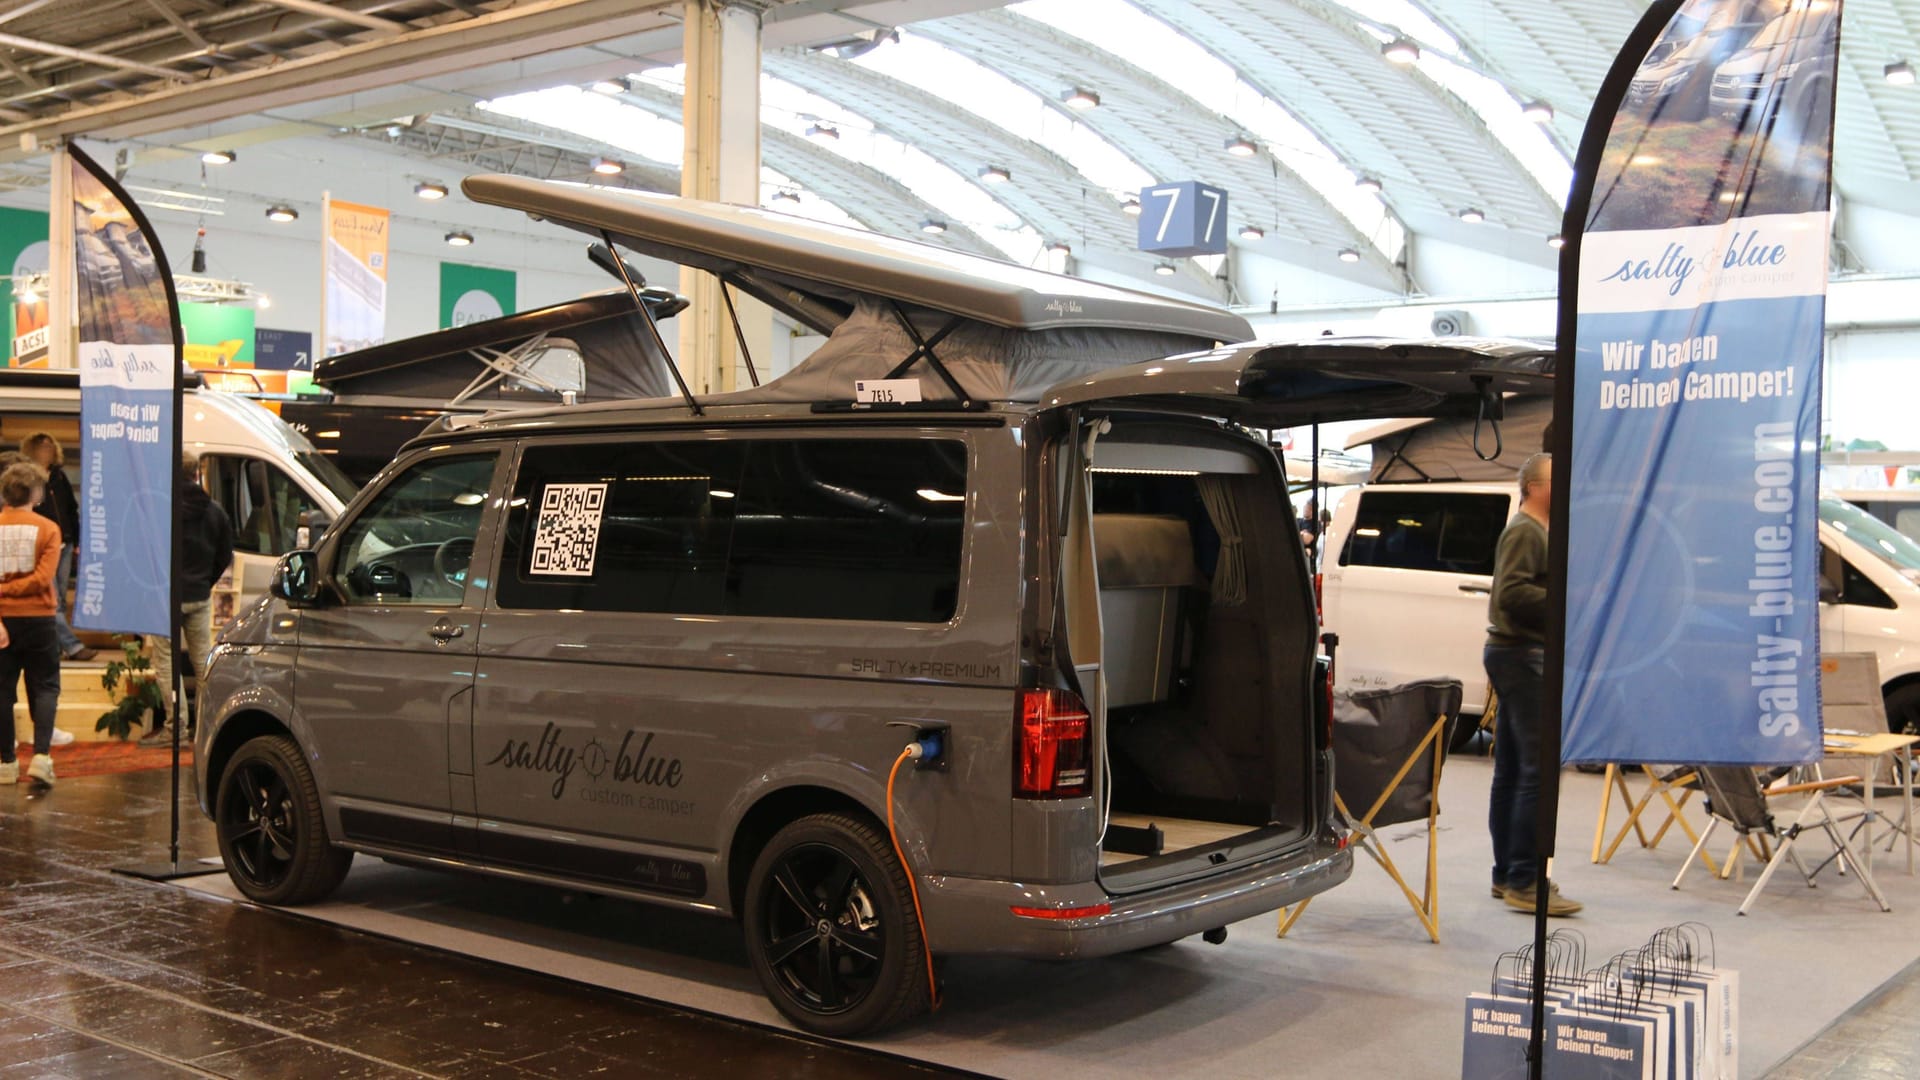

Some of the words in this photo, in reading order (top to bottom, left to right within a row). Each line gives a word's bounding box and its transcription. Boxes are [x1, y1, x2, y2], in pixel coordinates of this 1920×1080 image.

[1151, 187, 1181, 242] 7
[1202, 189, 1221, 243] 7
[1599, 242, 1694, 296] salty
[1722, 230, 1786, 269] blue
[21, 331, 46, 352] ACSI
[1602, 341, 1645, 371] Wir
[1685, 368, 1795, 402] Camper!
[1748, 421, 1802, 738] salty-blue.com
[852, 658, 908, 675] SALTY
[920, 661, 1001, 679] PREMIUM
[485, 721, 577, 800] salty
[612, 729, 684, 789] blue
[579, 787, 634, 807] custom
[639, 794, 697, 816] camper
[1472, 1022, 1505, 1036] Deinen
[1473, 1009, 1489, 1021] Wir
[1491, 1012, 1521, 1024] bauen
[1557, 1026, 1575, 1038] Wir
[1577, 1028, 1607, 1043] bauen
[1557, 1039, 1591, 1054] Deinen
[1593, 1045, 1633, 1061] Camper!
